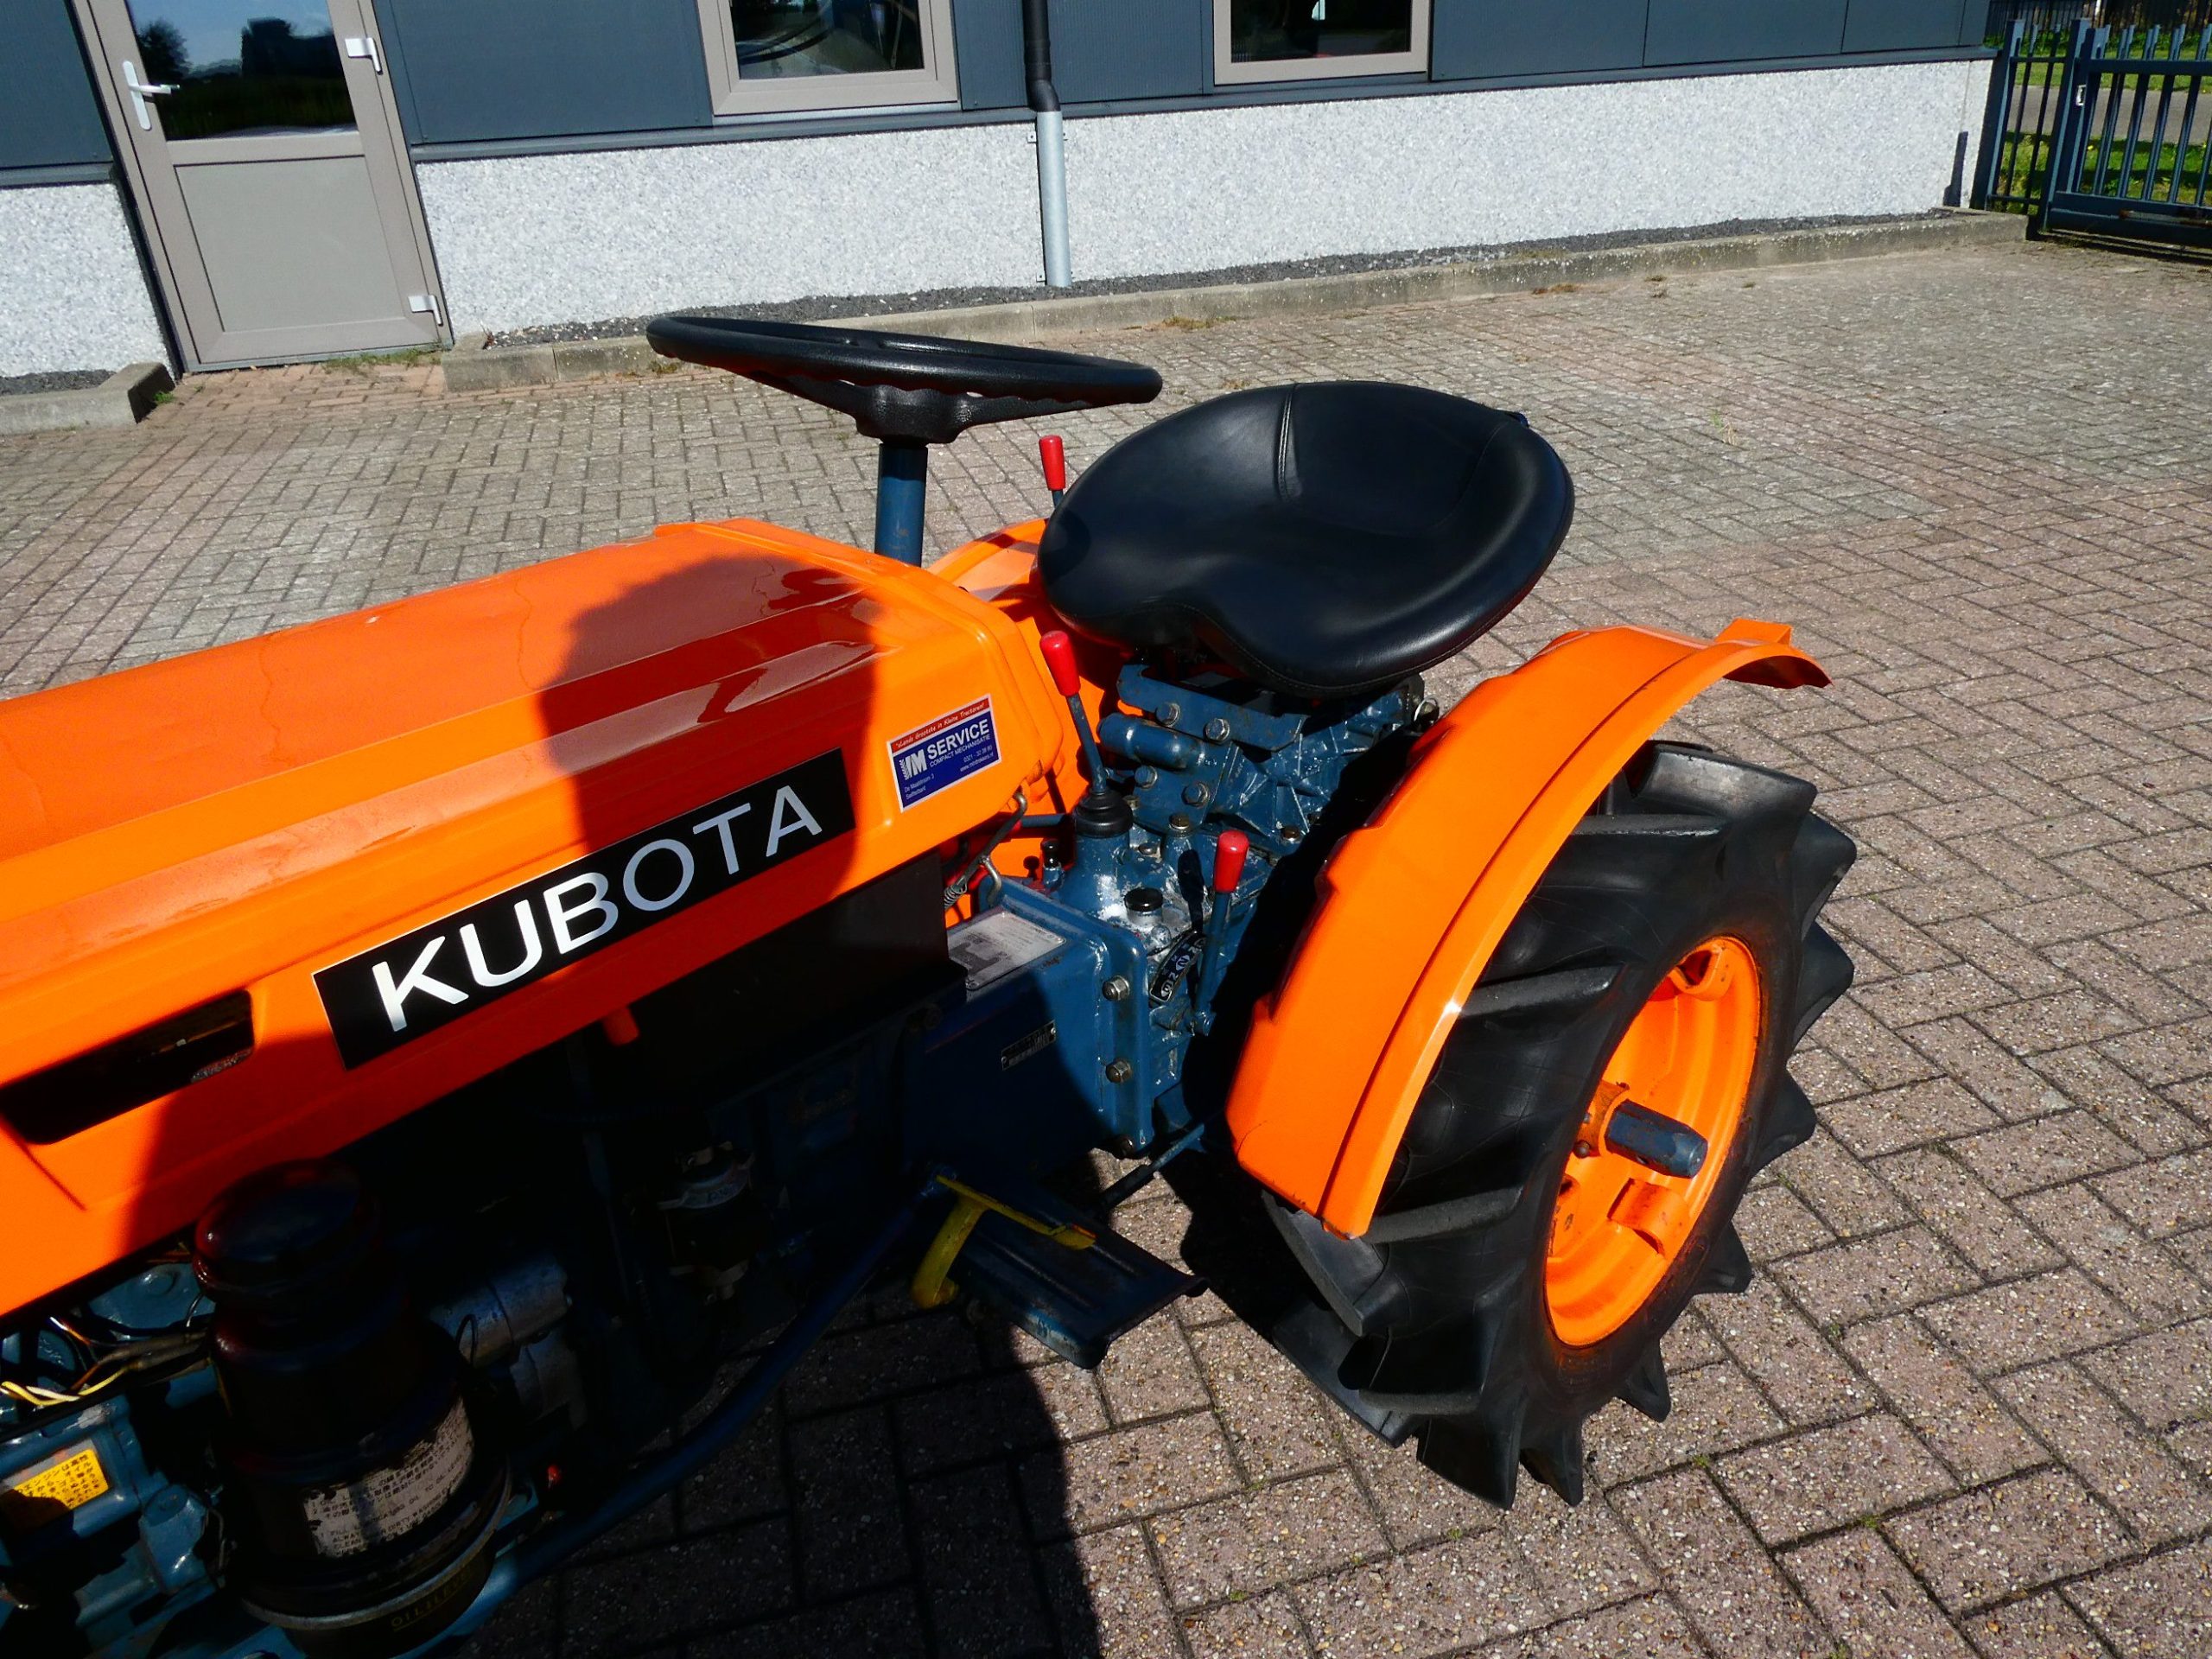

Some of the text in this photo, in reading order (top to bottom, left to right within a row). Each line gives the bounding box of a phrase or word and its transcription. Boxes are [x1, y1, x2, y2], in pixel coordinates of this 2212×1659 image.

[927, 719, 989, 760] SERVICE
[930, 734, 991, 768] COMPACT MECHANISATIE
[372, 785, 823, 1032] KUBOTA
